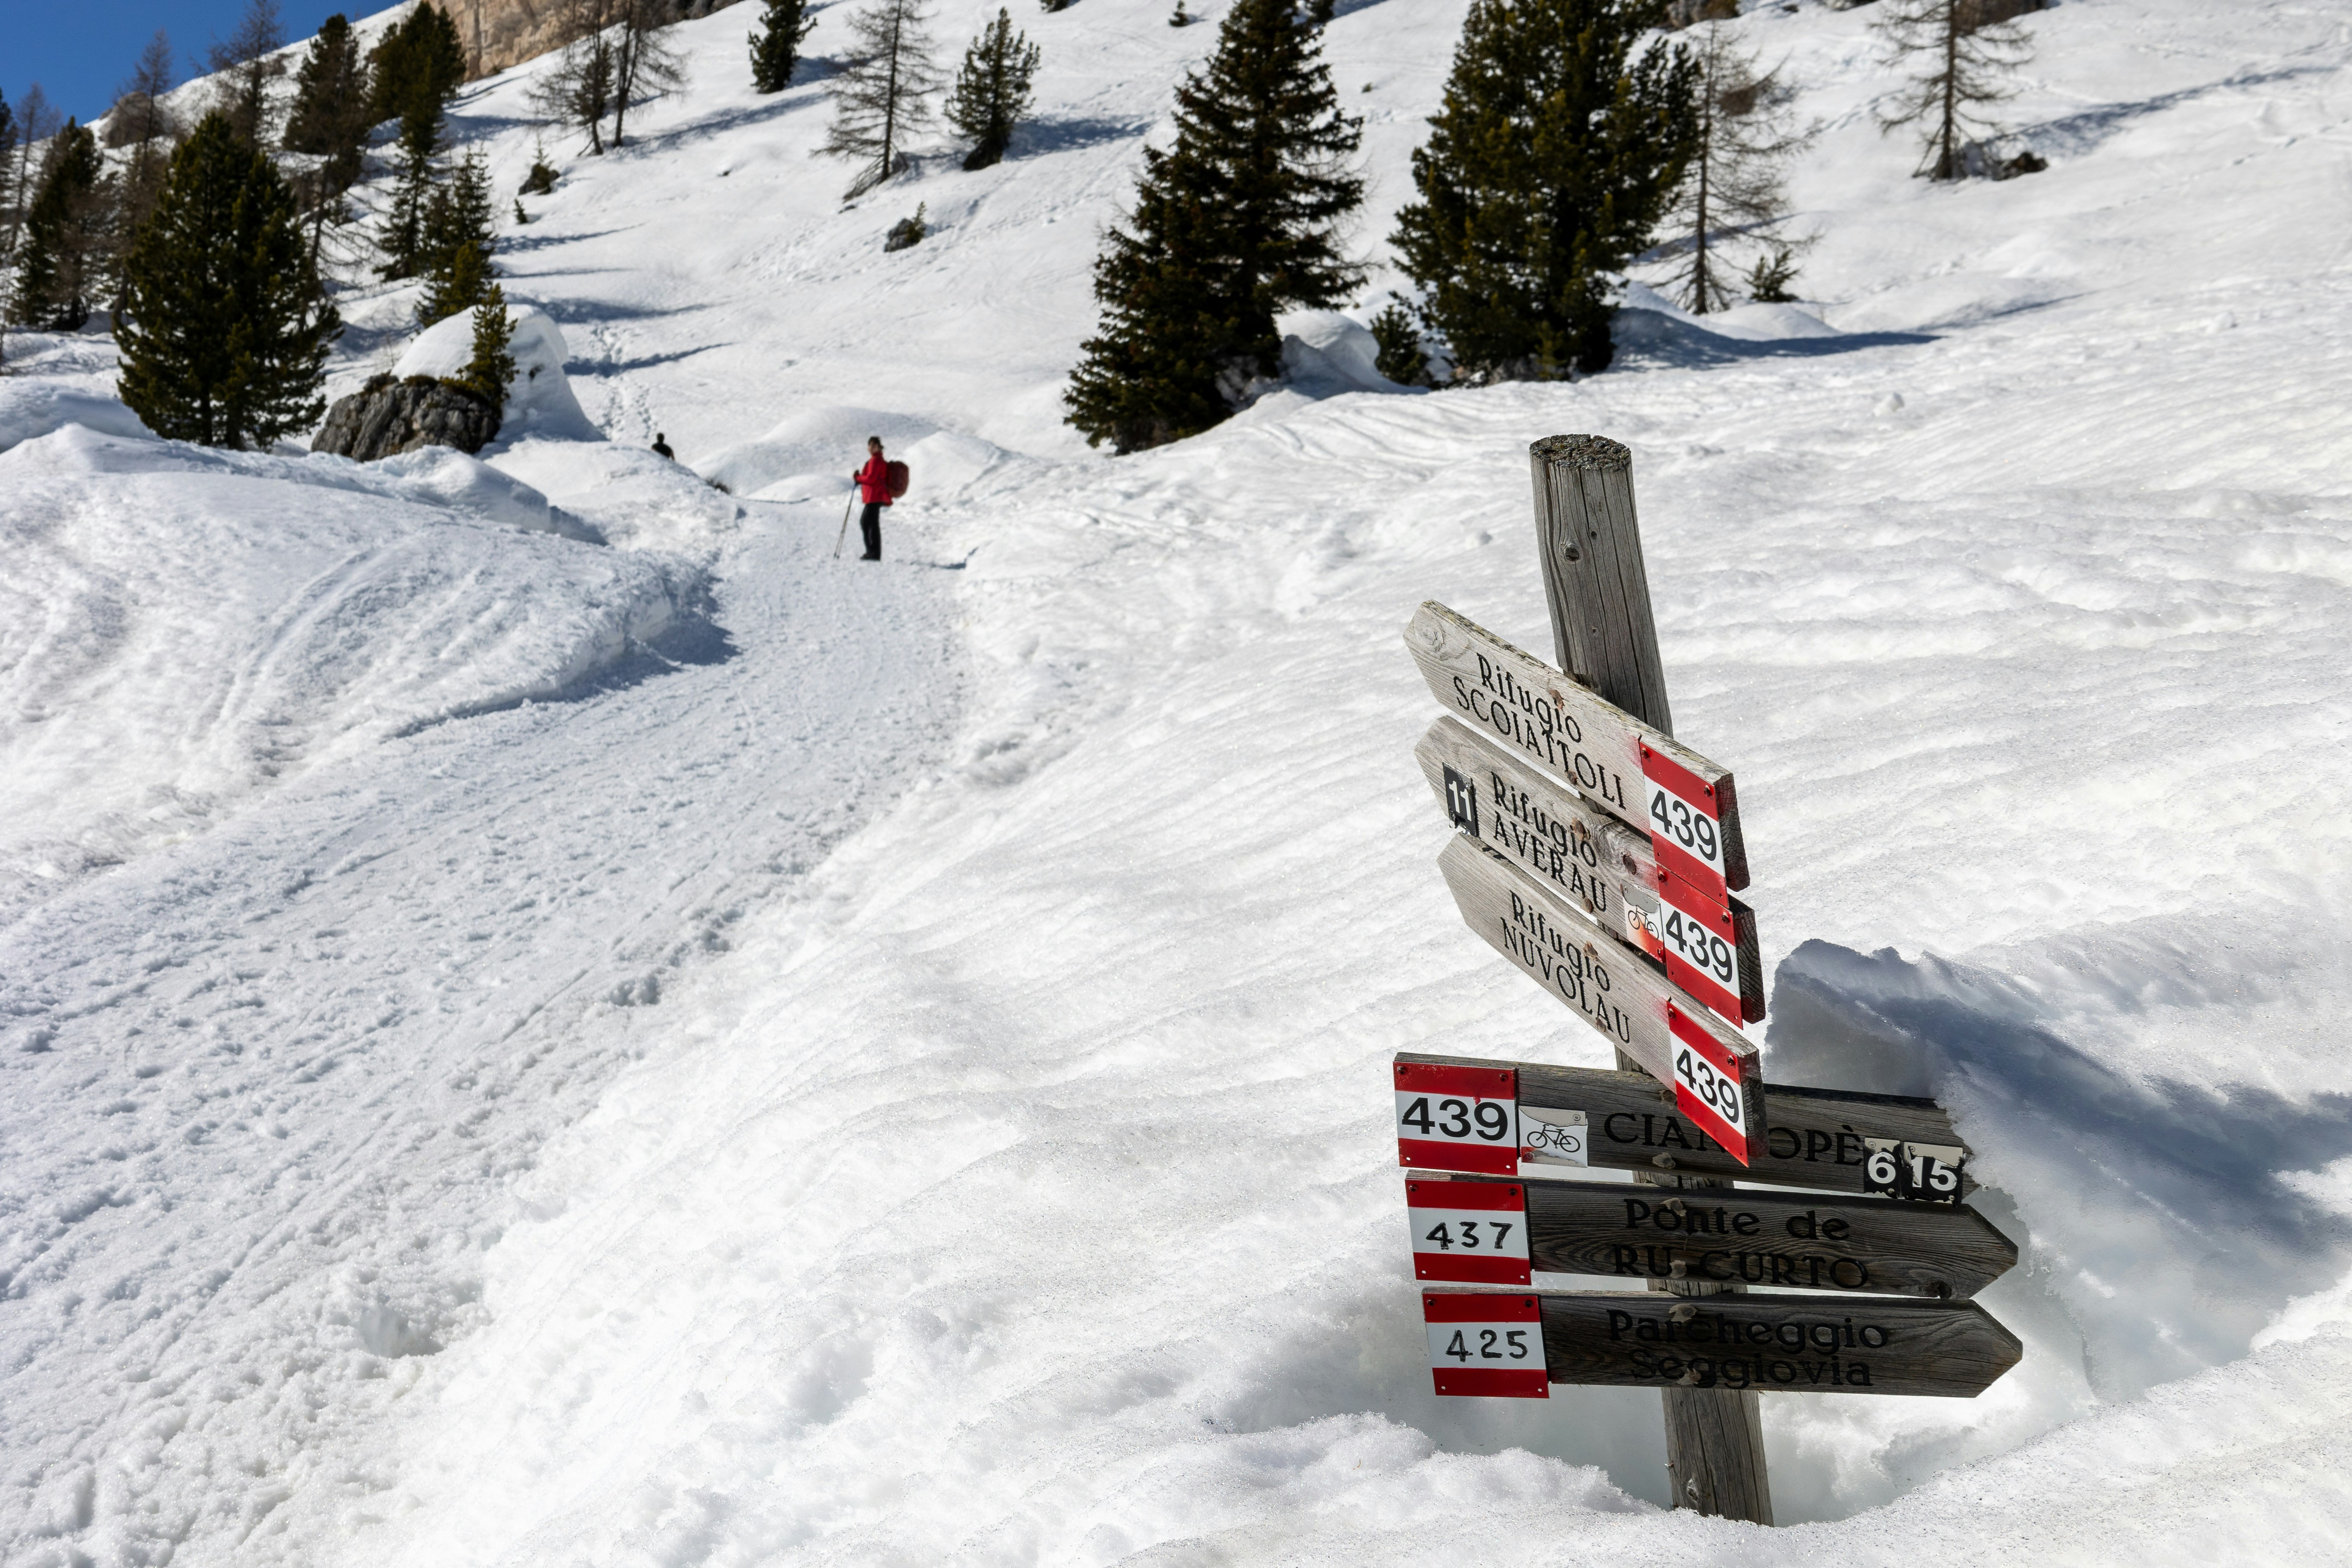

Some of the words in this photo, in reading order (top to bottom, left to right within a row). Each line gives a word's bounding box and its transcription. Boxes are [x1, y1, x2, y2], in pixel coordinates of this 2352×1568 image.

[1476, 652, 1582, 743] Rifugio
[1453, 676, 1626, 811] SCOIATTOLI
[1449, 781, 1472, 822] 11
[1490, 771, 1597, 868] Rifugio
[1651, 790, 1717, 862] 439
[1493, 811, 1607, 913] AVERAU
[1510, 889, 1610, 992] Rifugio
[1666, 910, 1733, 983] 439
[1500, 916, 1630, 1044] NUVOLAU
[1676, 1048, 1739, 1124] 439
[1401, 1096, 1508, 1141] 439
[1604, 1112, 1863, 1166] CIAOPÈ
[1868, 1152, 1957, 1191] 615
[1425, 1221, 1513, 1250] 437
[1623, 1198, 1760, 1236] Ponte
[1785, 1210, 1851, 1240] de
[1611, 1243, 1673, 1277] RU
[1699, 1250, 1868, 1289] CURTO
[1445, 1329, 1528, 1363] 425
[1606, 1309, 1888, 1355] Parcheggio
[1628, 1348, 1874, 1390] Seggiovia
